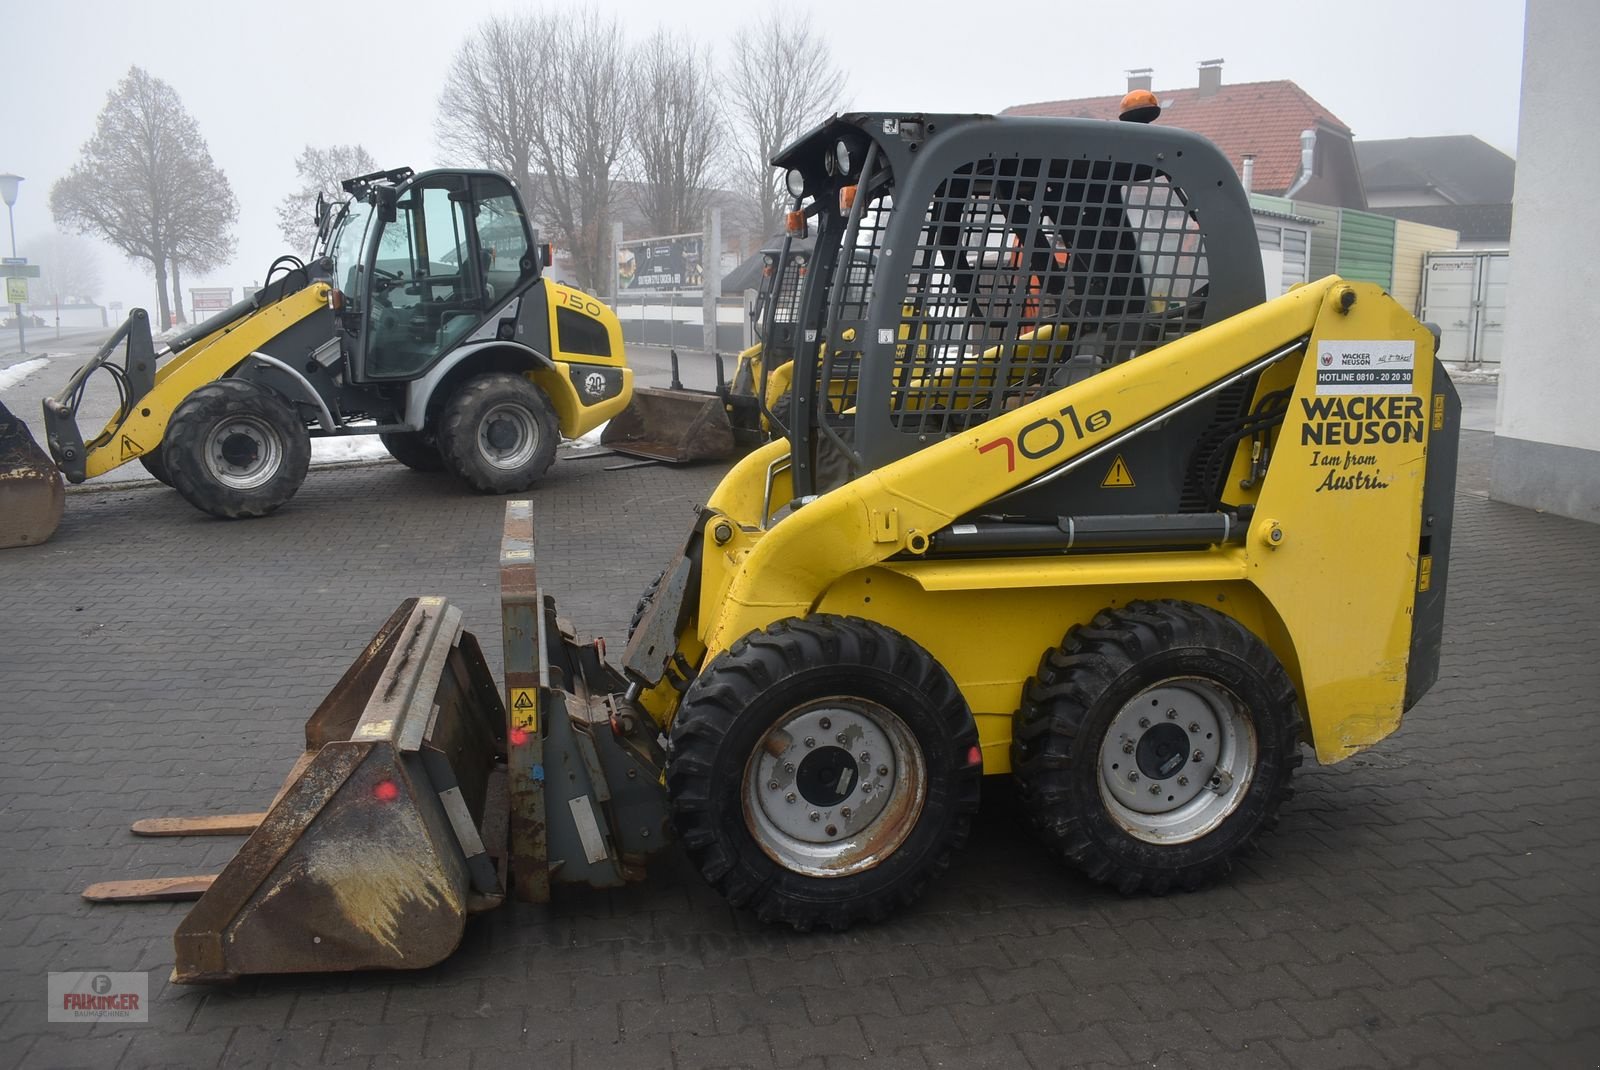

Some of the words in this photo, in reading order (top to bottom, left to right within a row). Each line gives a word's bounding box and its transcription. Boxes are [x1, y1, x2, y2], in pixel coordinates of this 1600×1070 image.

[556, 290, 601, 317] 750
[1319, 373, 1355, 381] HOTLINE
[1356, 373, 1374, 381] 0810
[1380, 373, 1390, 381] 20
[1391, 373, 1401, 381] 20
[1402, 372, 1411, 381] 30
[1300, 396, 1424, 421] WACKER
[1301, 421, 1424, 446] NEUSON
[1310, 451, 1321, 466] I
[1321, 454, 1342, 466] am
[1343, 450, 1378, 470] from
